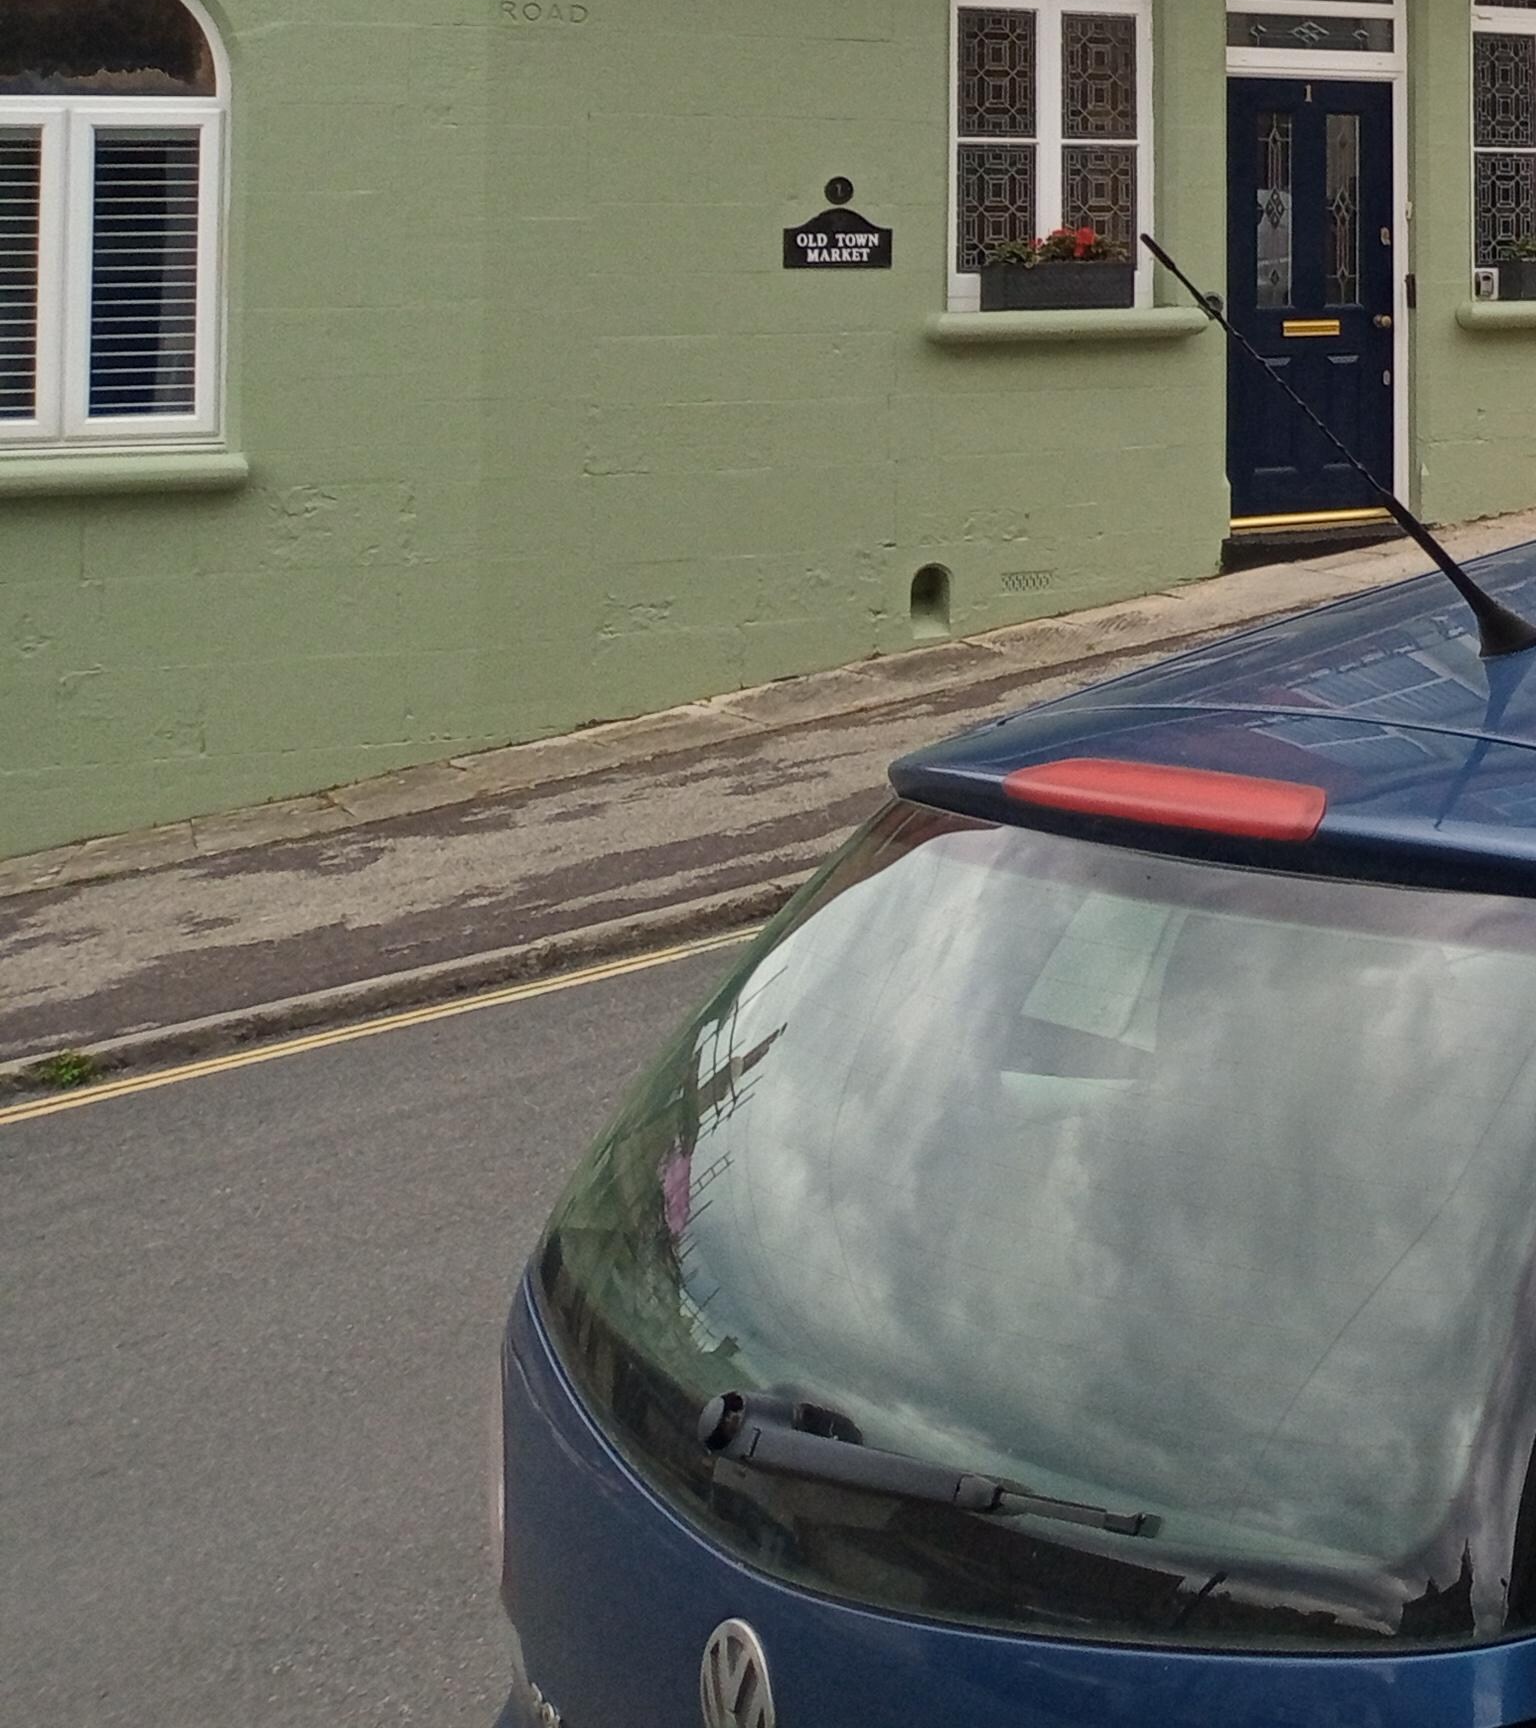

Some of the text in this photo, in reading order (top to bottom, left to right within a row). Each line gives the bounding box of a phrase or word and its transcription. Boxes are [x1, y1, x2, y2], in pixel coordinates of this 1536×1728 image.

[500, 0, 588, 23] ROAD
[1304, 84, 1313, 103] 1
[796, 233, 880, 247] OLD TOWN
[806, 248, 871, 263] MARKET
